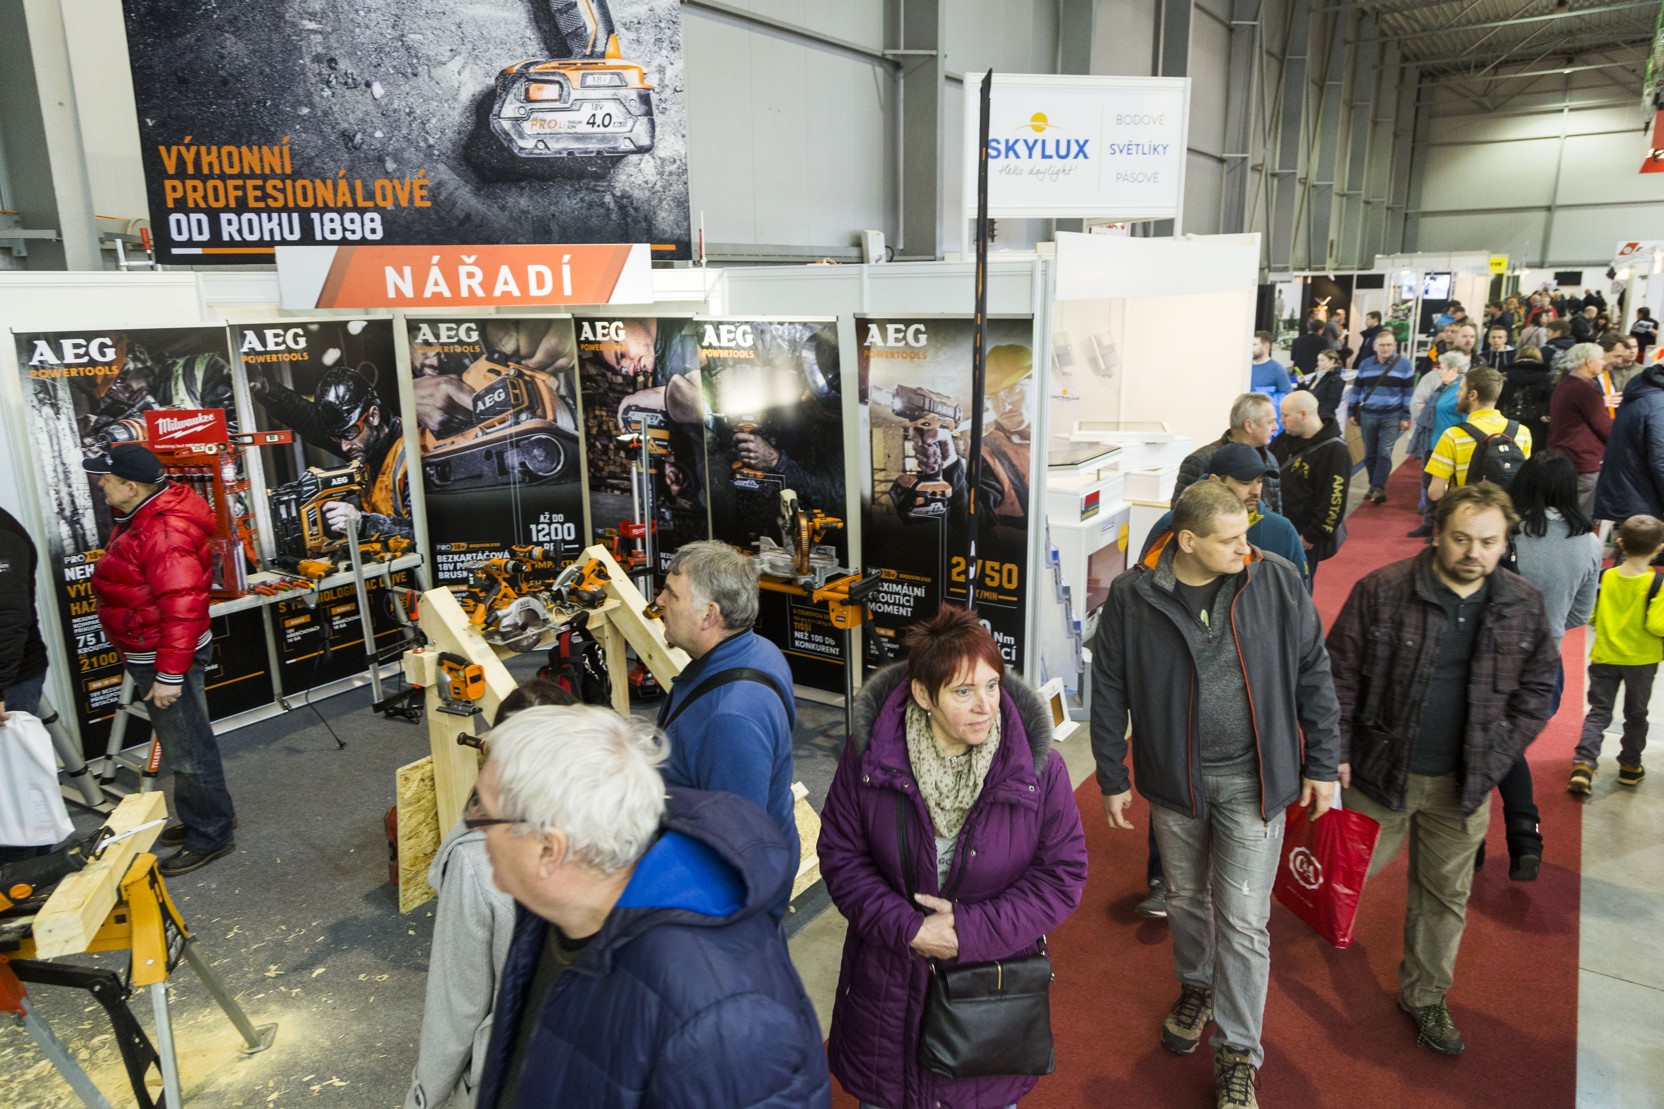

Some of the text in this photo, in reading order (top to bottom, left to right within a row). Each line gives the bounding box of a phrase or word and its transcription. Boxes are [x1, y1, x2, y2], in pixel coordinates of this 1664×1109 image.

[586, 112, 612, 129] 4.0
[1115, 112, 1166, 126] BODOVÉ
[158, 135, 293, 175] VÝKONNÍ
[987, 138, 1090, 160] SKYLUX
[1109, 141, 1169, 156] SVĚTLÍKY
[1115, 170, 1160, 184] PÁSOVÉ
[163, 168, 433, 209] PROFESIONÁLOVÉ
[168, 211, 384, 242] OD ROKU 1898
[384, 254, 574, 299] NÁŘADÍ
[415, 322, 480, 343] AEG
[580, 321, 626, 342] AEG
[702, 324, 754, 347] AEG
[863, 323, 928, 348] AEG
[240, 327, 307, 353] AEG
[28, 337, 117, 366] AEG
[241, 352, 309, 364] POWERTOOLS
[702, 348, 755, 359] POWERTOOLS
[863, 349, 928, 360] POWERTOOLS
[28, 365, 120, 379] POWERTOOLS
[476, 388, 506, 414] AEG
[154, 412, 216, 435] Milwaukee
[331, 476, 349, 486] AEG
[539, 512, 564, 523] AŽ DO
[529, 522, 576, 542] 1200
[63, 554, 86, 565] PRO
[436, 549, 511, 563] BEZKARTÁČOVÁ
[438, 563, 455, 571] 18V
[867, 567, 881, 575] PRO
[438, 570, 468, 580] BRUSK
[878, 582, 926, 598] XIMÁLNÍ
[878, 592, 915, 607] OUTÍCÍ
[867, 602, 913, 617] MOMENT
[76, 633, 97, 648] 75
[794, 629, 810, 641] NEŽ
[993, 631, 1016, 645] Nm
[794, 639, 841, 656] KONKURENT
[80, 651, 119, 671] 2100
